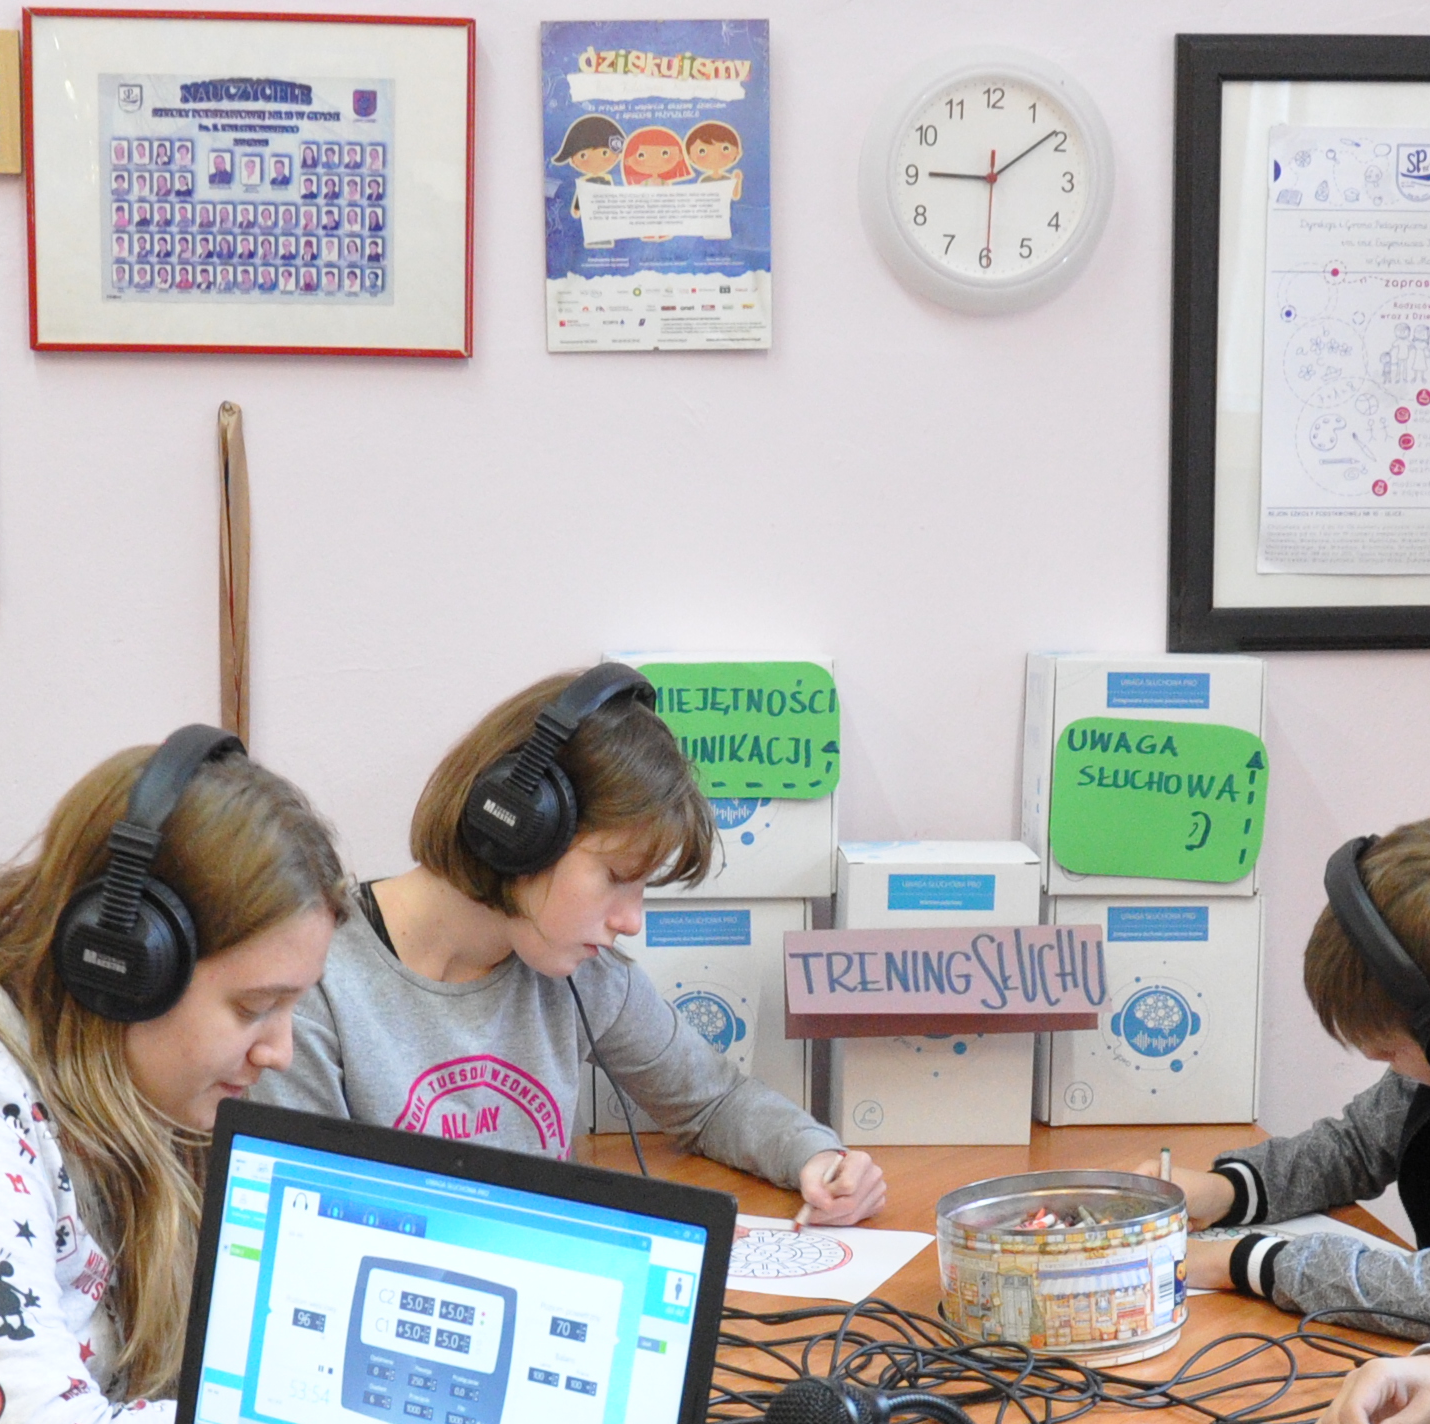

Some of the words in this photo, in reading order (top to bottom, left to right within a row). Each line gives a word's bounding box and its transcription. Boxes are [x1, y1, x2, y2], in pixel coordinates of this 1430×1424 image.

[945, 98, 964, 120] 11
[983, 88, 1005, 109] 12
[1028, 103, 1037, 123] 1
[915, 124, 938, 146] 10
[1053, 131, 1067, 153] 2
[905, 164, 919, 186] 9
[1061, 171, 1075, 193] 3
[913, 204, 927, 226] 8
[1047, 212, 1061, 232] 4
[943, 234, 956, 255] 7
[1019, 238, 1033, 259] 5
[978, 247, 992, 269] 6
[1067, 728, 1179, 757] UWAGA
[1077, 765, 1241, 803] SŁUCHOWA
[789, 950, 974, 995] TRENING
[971, 928, 1107, 1010] SŁUCHU
[491, 1066, 557, 1140] WEDNESDAY
[441, 1112, 471, 1140] ALL
[378, 1288, 396, 1305] C2
[297, 1311, 311, 1327] 96
[555, 1320, 571, 1336] 70
